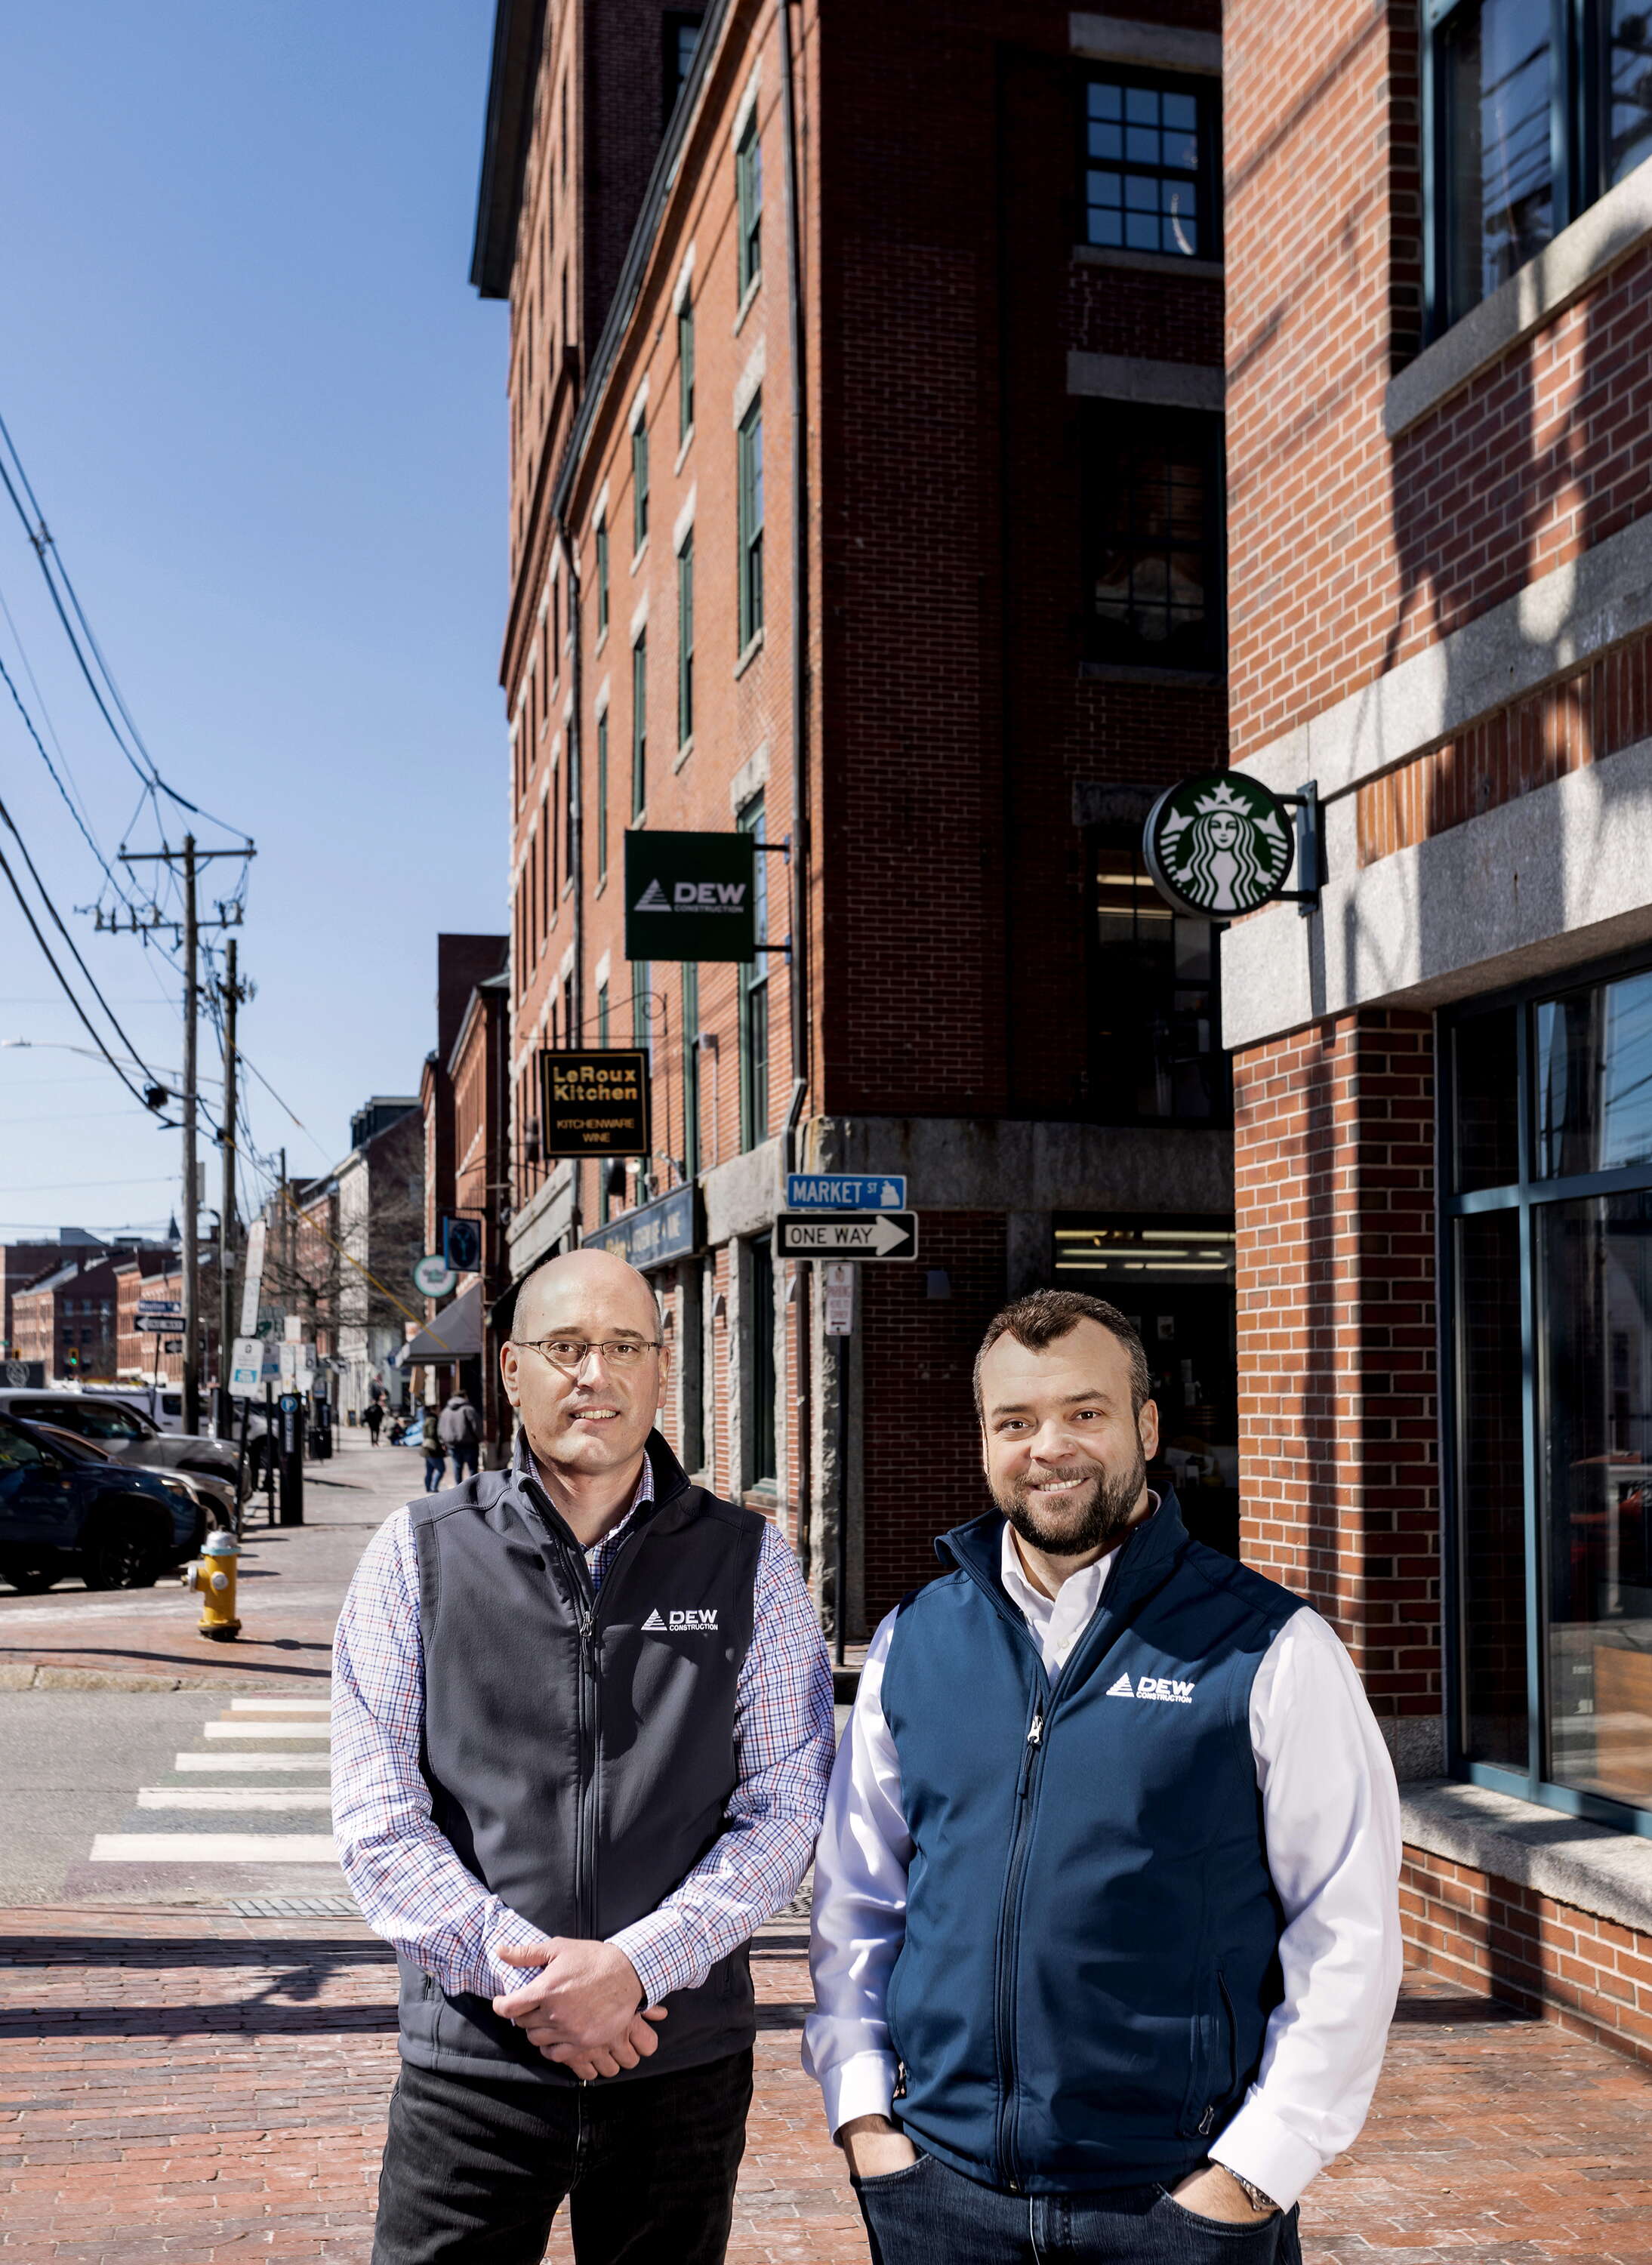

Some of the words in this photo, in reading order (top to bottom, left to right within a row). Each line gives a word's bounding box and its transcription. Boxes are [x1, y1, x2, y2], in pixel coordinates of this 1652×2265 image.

[674, 882, 746, 904] DEW
[553, 1066, 636, 1083] LeRoux
[554, 1084, 637, 1101] Kitchen
[556, 1118, 634, 1129] KITCHENWARE
[582, 1132, 610, 1142] WINE
[794, 1180, 862, 1203] MARKET
[868, 1183, 877, 1194] ST
[791, 1228, 827, 1244] ONE
[835, 1227, 874, 1244] WAY
[669, 1610, 717, 1625] DEW
[1138, 1676, 1195, 1696] DEW
[1136, 1691, 1192, 1703] CONSTRUCTION
